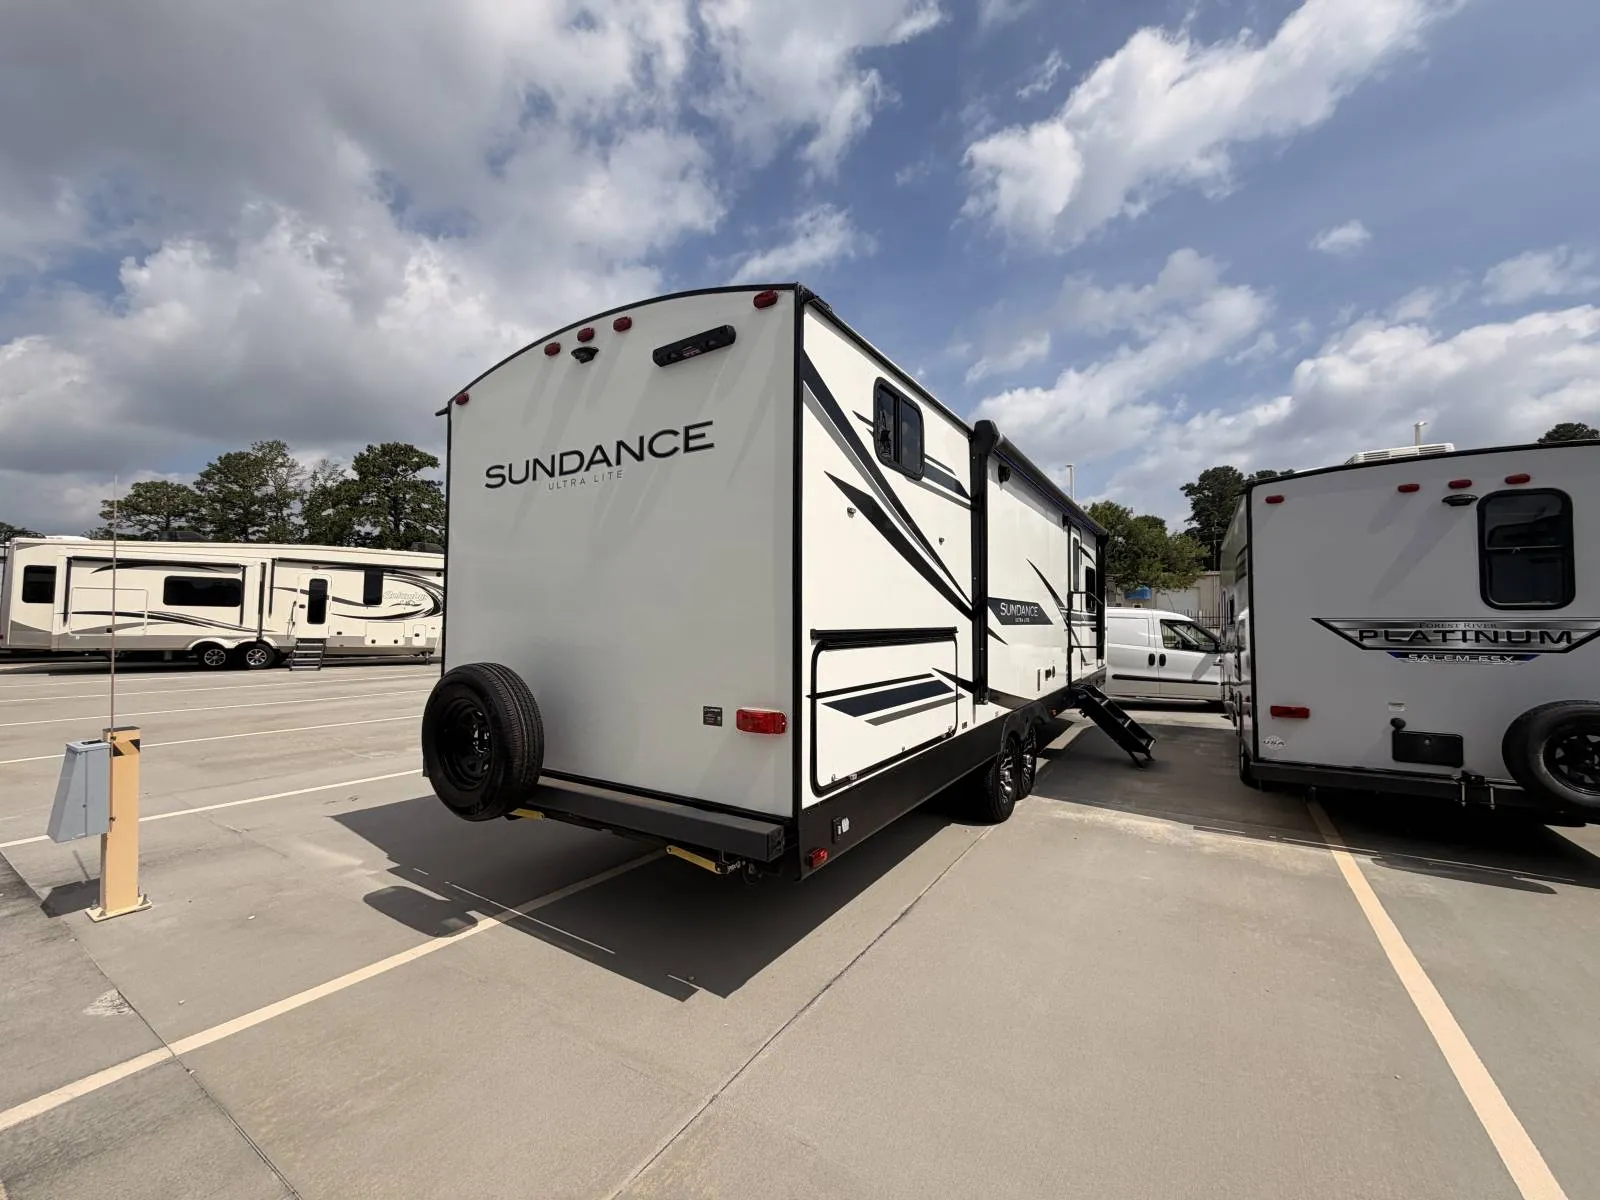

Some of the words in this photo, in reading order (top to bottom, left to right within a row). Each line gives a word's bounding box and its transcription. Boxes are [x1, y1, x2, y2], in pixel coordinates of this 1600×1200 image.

[484, 420, 715, 489] SUNDANCE
[548, 475, 586, 490] ULTRA
[593, 469, 624, 483] LITE
[1000, 602, 1039, 617] SUNDANCE
[1463, 622, 1498, 630] RIVER
[1358, 629, 1574, 645] PLATINUM
[1408, 653, 1470, 663] SALEM
